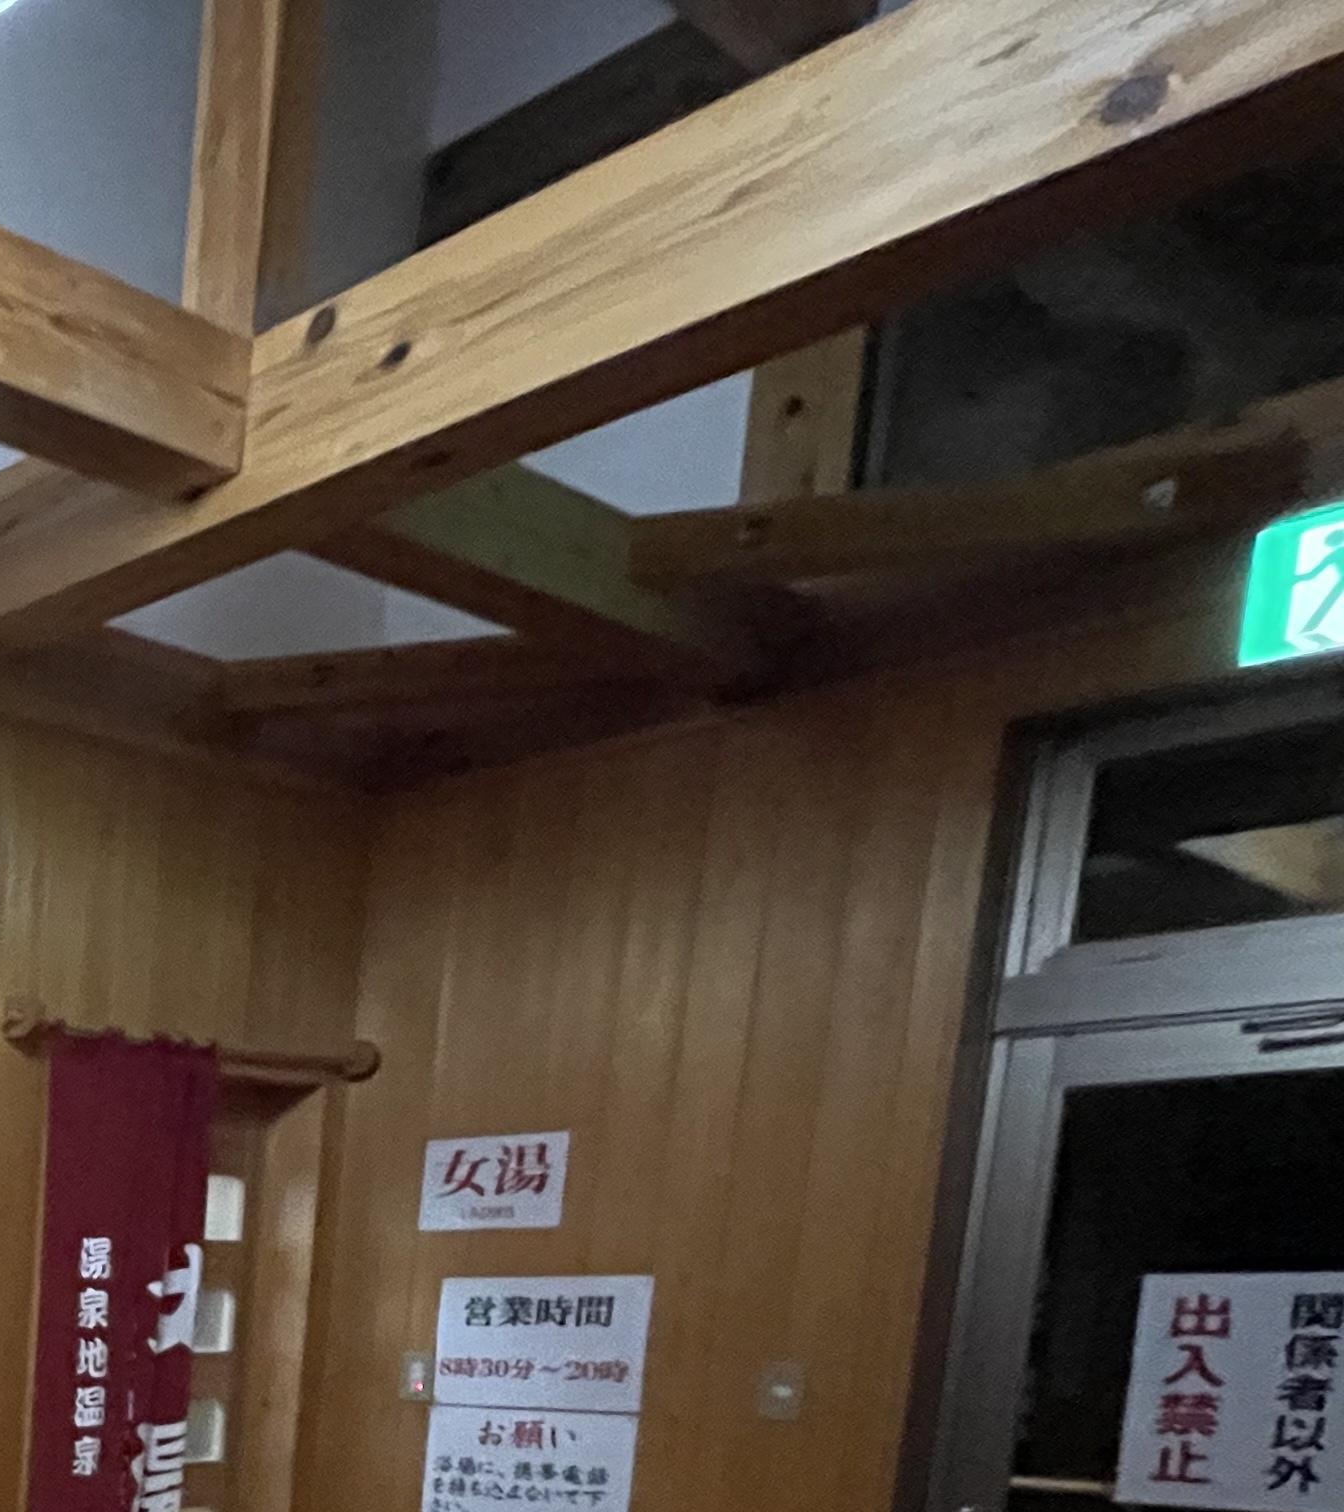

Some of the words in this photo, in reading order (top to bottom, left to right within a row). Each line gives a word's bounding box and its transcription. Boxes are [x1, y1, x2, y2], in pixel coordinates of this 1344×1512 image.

[435, 1142, 550, 1197] 女湯
[465, 1295, 614, 1328] 営業時間
[1149, 1293, 1232, 1484] 出入禁止
[1264, 1292, 1344, 1493] 関係者以外
[479, 1420, 577, 1449] お願い
